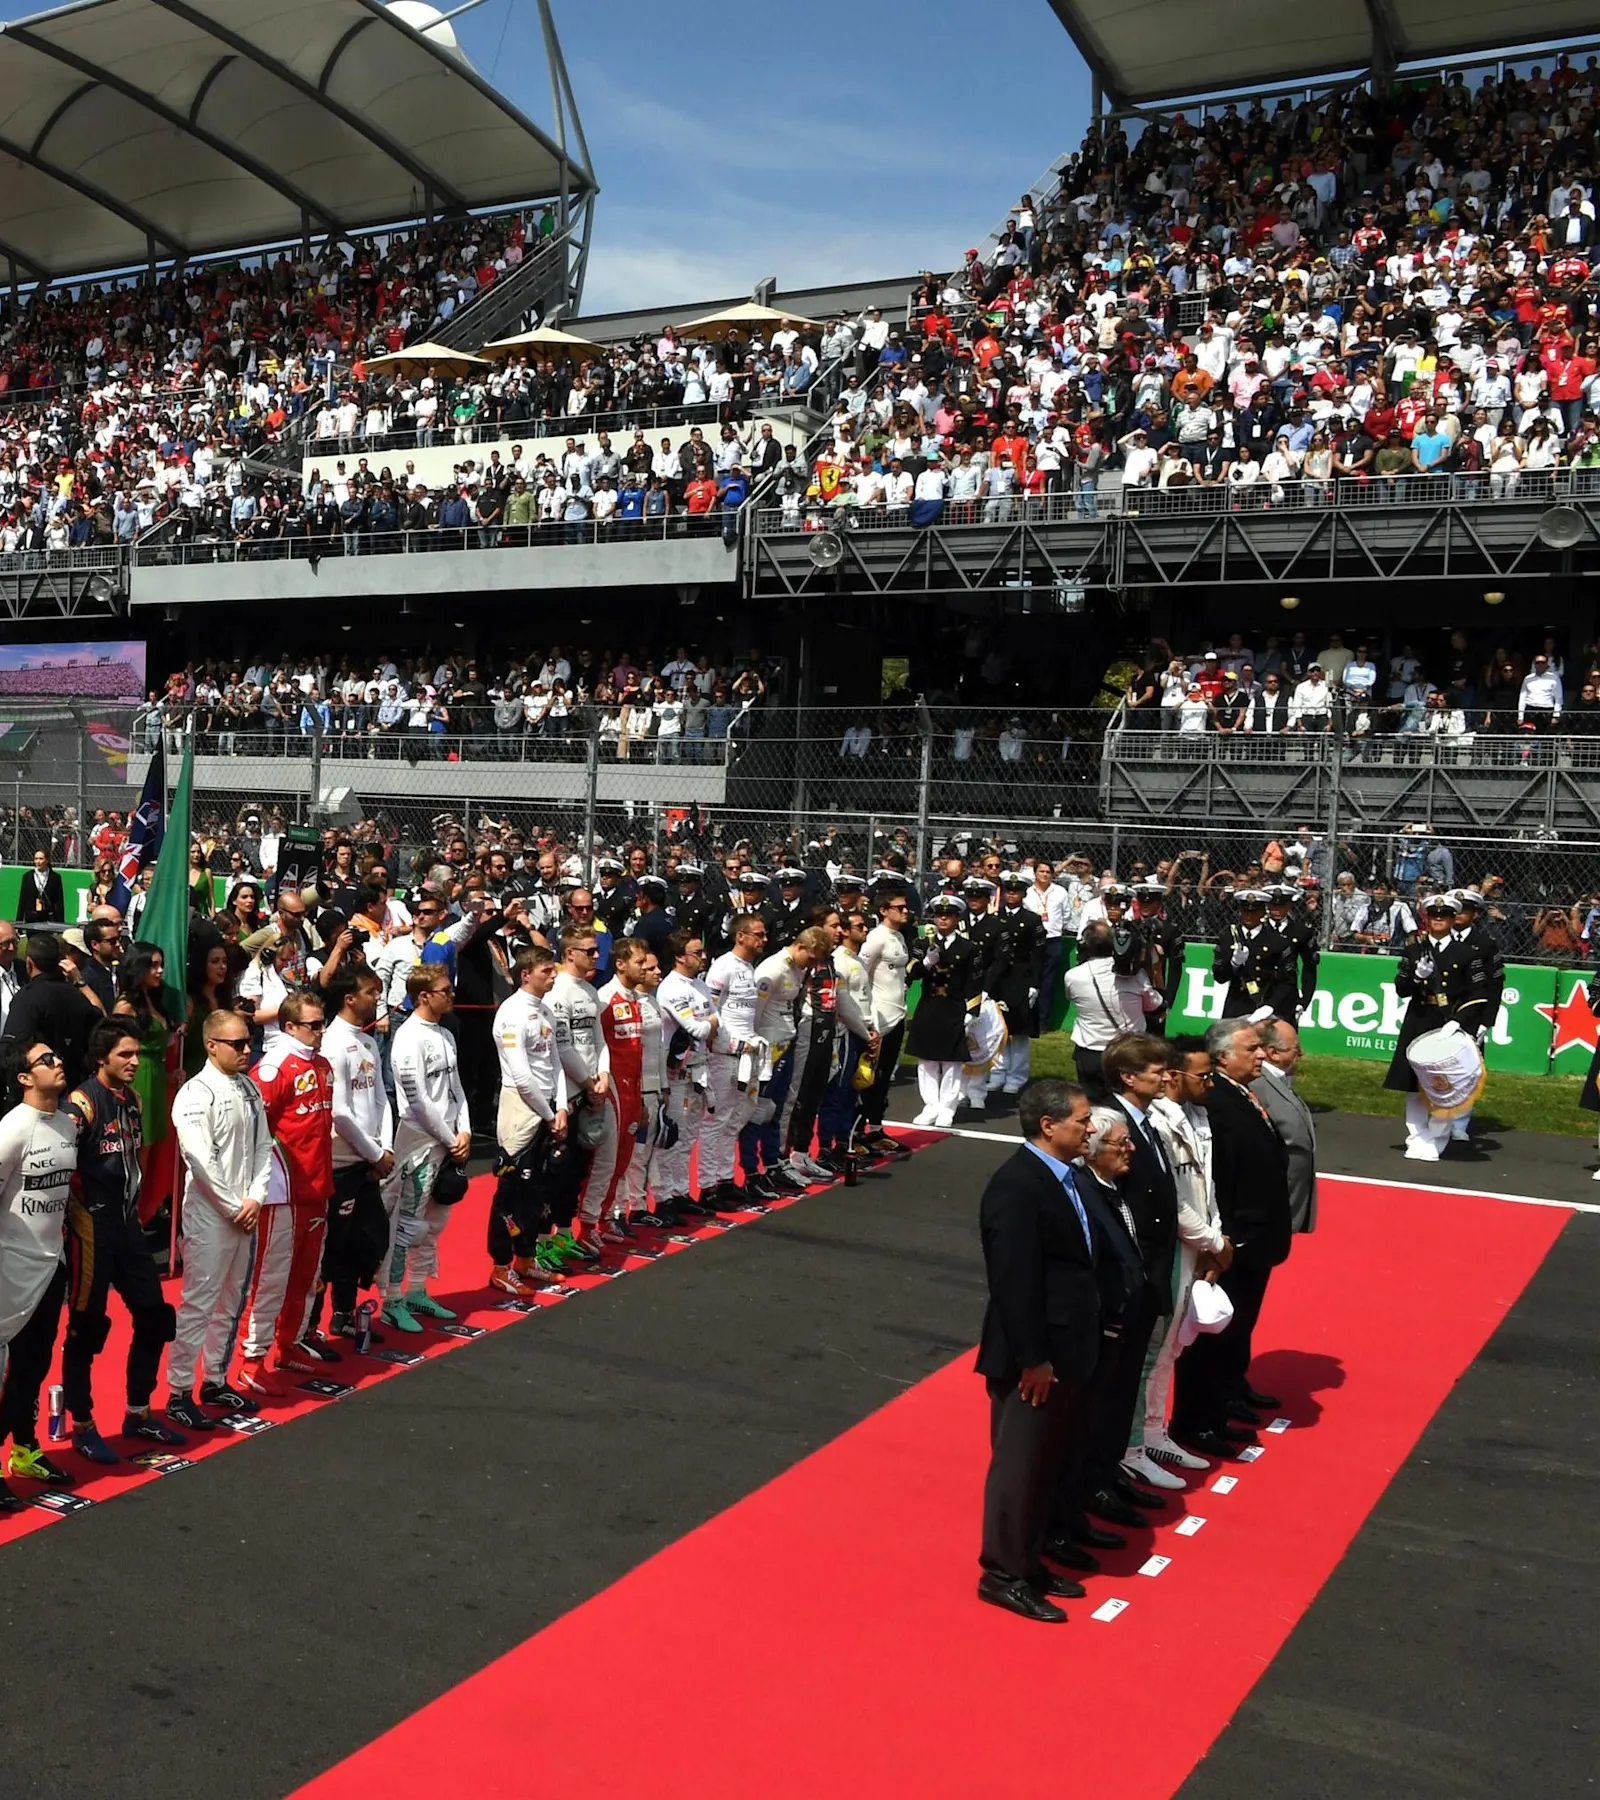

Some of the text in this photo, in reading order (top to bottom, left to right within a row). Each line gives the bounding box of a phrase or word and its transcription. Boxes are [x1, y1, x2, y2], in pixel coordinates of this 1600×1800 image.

[1346, 1035, 1371, 1049] EVITA
[1373, 1038, 1386, 1050] EL
[30, 1158, 57, 1169] NEC
